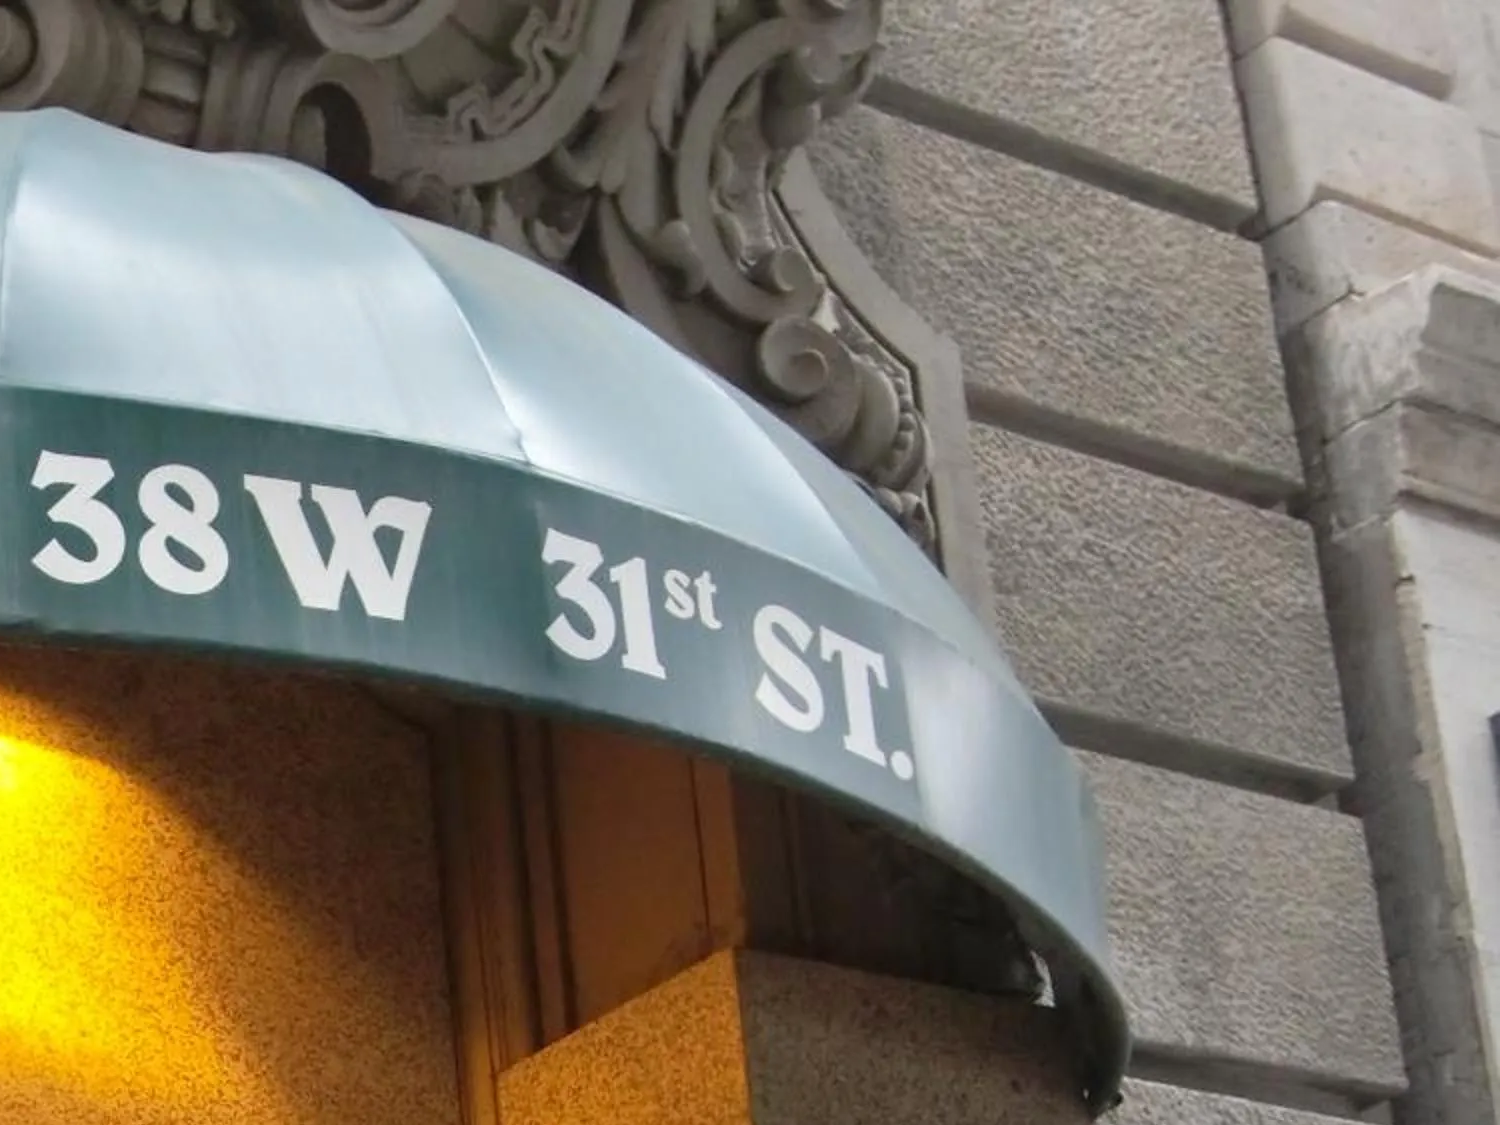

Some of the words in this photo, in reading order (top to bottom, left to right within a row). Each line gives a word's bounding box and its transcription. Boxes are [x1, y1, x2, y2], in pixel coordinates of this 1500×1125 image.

[29, 449, 230, 596] 38
[243, 473, 433, 622] W
[540, 527, 722, 681] 31st
[752, 603, 916, 782] ST.
